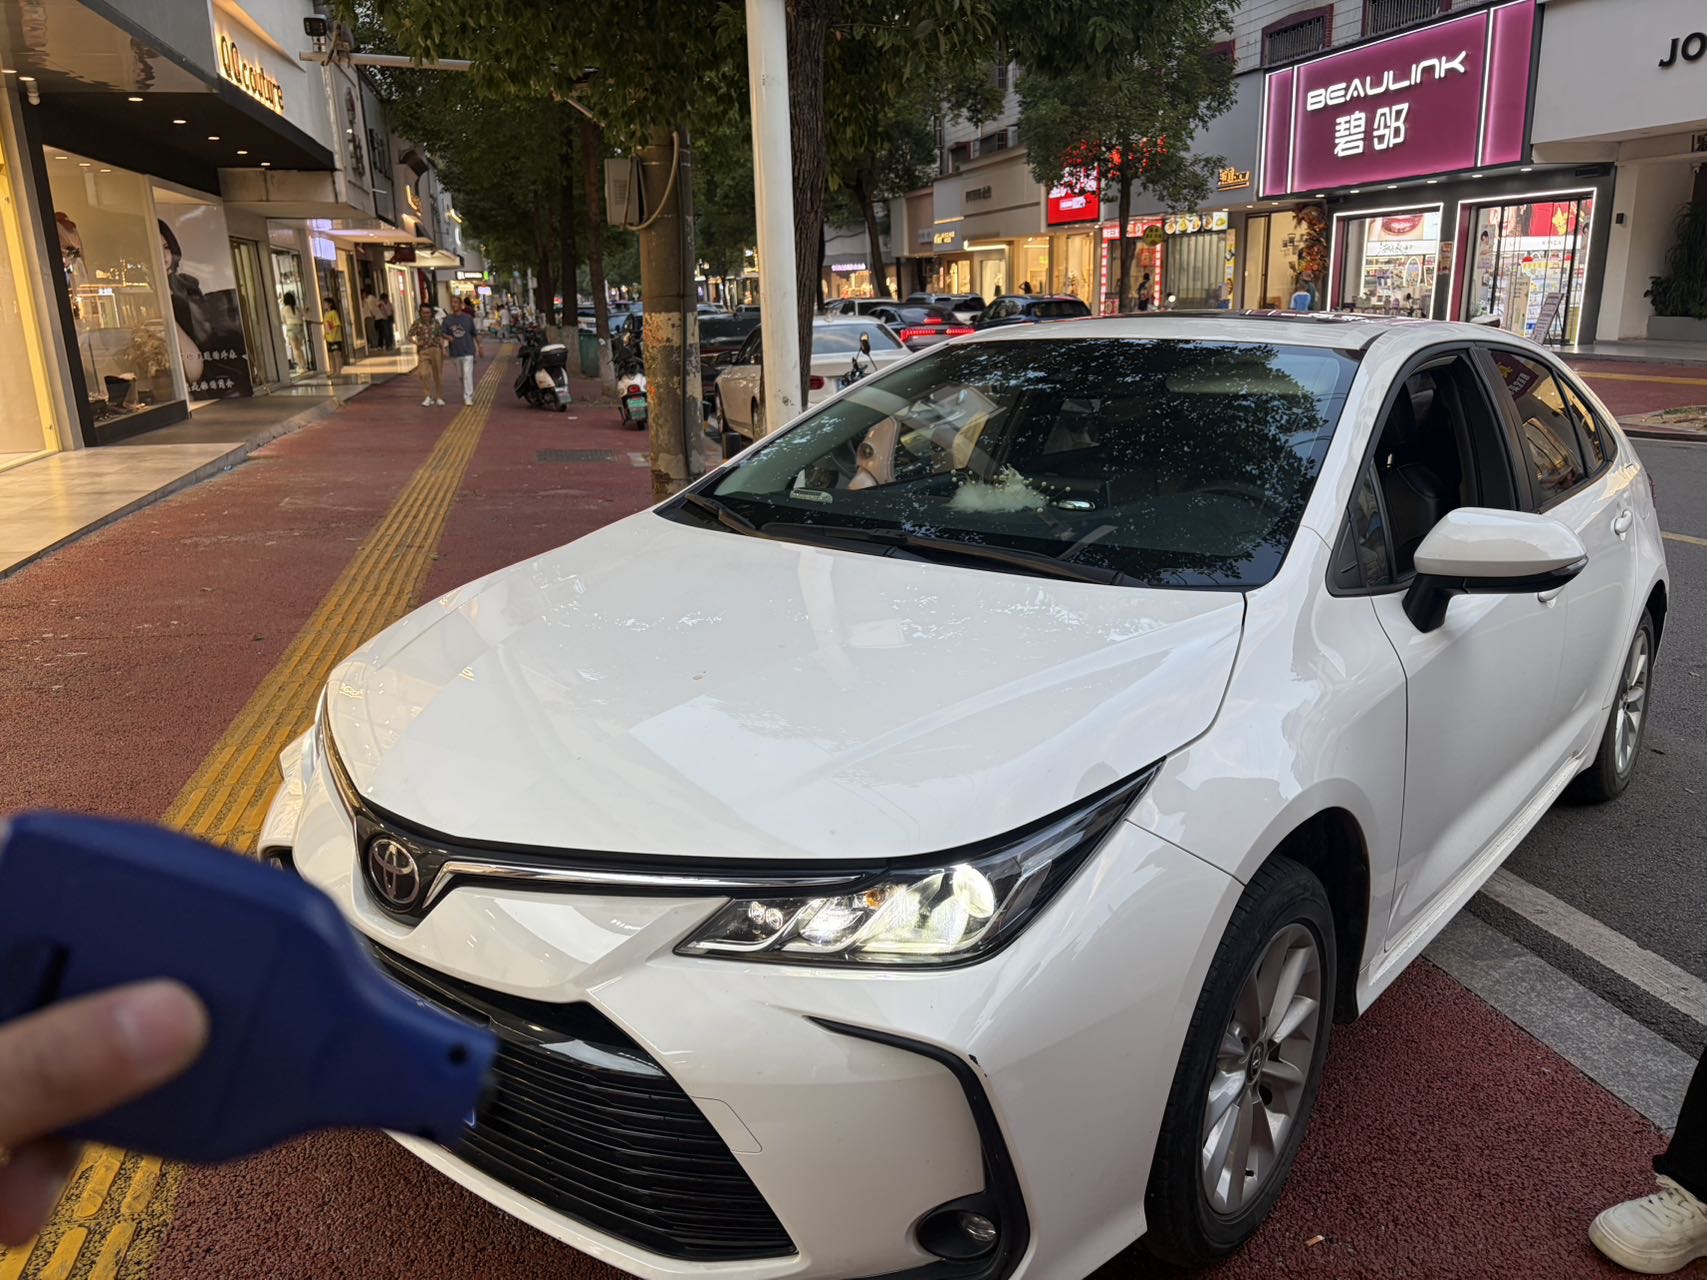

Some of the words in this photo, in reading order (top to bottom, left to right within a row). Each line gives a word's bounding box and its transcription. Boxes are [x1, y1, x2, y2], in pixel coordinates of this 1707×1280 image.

[1658, 32, 1707, 67] JO
[1306, 50, 1467, 111] BEAULINK
[1333, 102, 1409, 157] 碧邻
